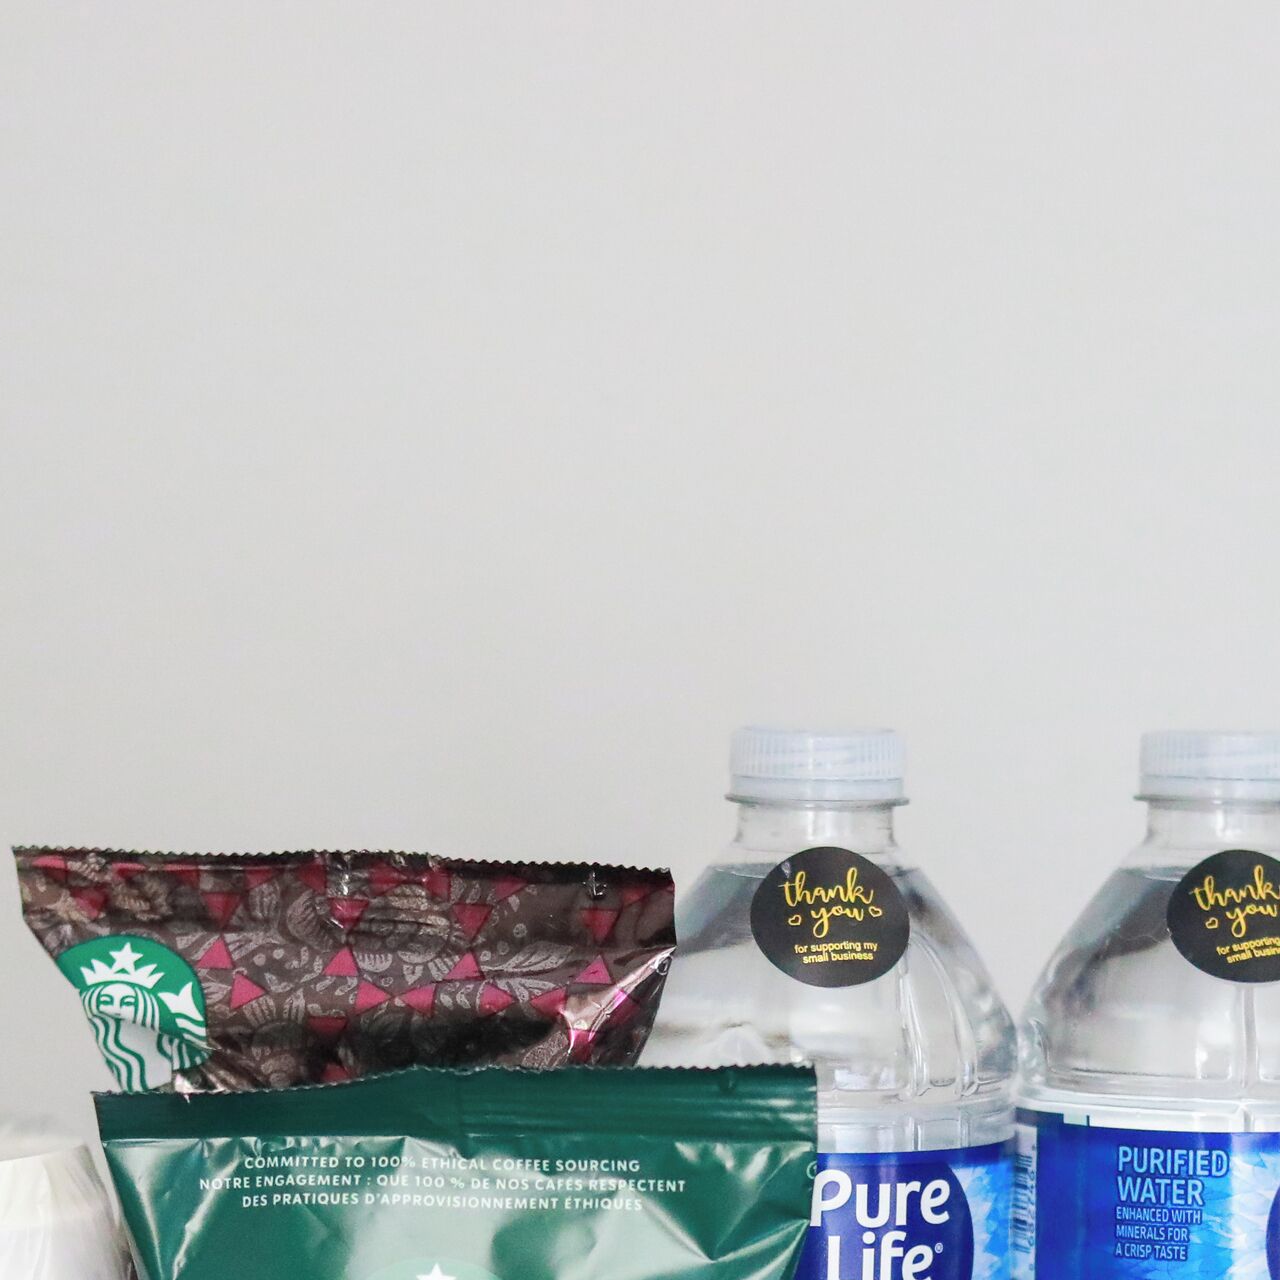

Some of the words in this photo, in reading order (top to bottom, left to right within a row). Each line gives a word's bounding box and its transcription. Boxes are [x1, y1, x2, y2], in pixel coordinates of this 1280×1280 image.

[778, 867, 874, 907] thank
[810, 905, 864, 938] you
[1225, 903, 1277, 938] you
[794, 944, 808, 954] for
[810, 940, 862, 952] supporting
[863, 941, 878, 951] my
[1216, 946, 1230, 955] for
[1232, 936, 1280, 951] supporting
[802, 952, 829, 964] small
[831, 951, 874, 962] business
[1227, 949, 1253, 964] small
[244, 1156, 339, 1169] COMMITTED
[345, 1156, 365, 1168] TO
[371, 1156, 416, 1168] 100%
[422, 1157, 486, 1170] ETHICAL
[493, 1158, 550, 1171] COFFEE
[556, 1159, 641, 1172] SOURCING
[1117, 1145, 1229, 1177] PURIFIED
[200, 1177, 251, 1190] NOTRE
[255, 1174, 361, 1187] ENGAGEMENT
[377, 1174, 409, 1187] QUE
[416, 1175, 445, 1188] 100
[450, 1178, 465, 1189] %
[471, 1178, 490, 1190] DE
[496, 1178, 529, 1190] NOS
[589, 1178, 686, 1192] RESPECTENT
[1117, 1176, 1204, 1206] WATER
[242, 1195, 268, 1208] DES
[272, 1193, 359, 1205] PRATIQUES
[365, 1193, 558, 1209] D'APPROVISIONNEMENT
[809, 1169, 951, 1229] Pure
[1116, 1206, 1169, 1222] ENHANCED
[1171, 1209, 1201, 1224] WITH
[1116, 1224, 1166, 1240] MINERALS
[1167, 1227, 1188, 1241] FOR
[1115, 1243, 1123, 1256] A
[1124, 1243, 1152, 1258] CRISP
[1154, 1245, 1186, 1260] TASTE
